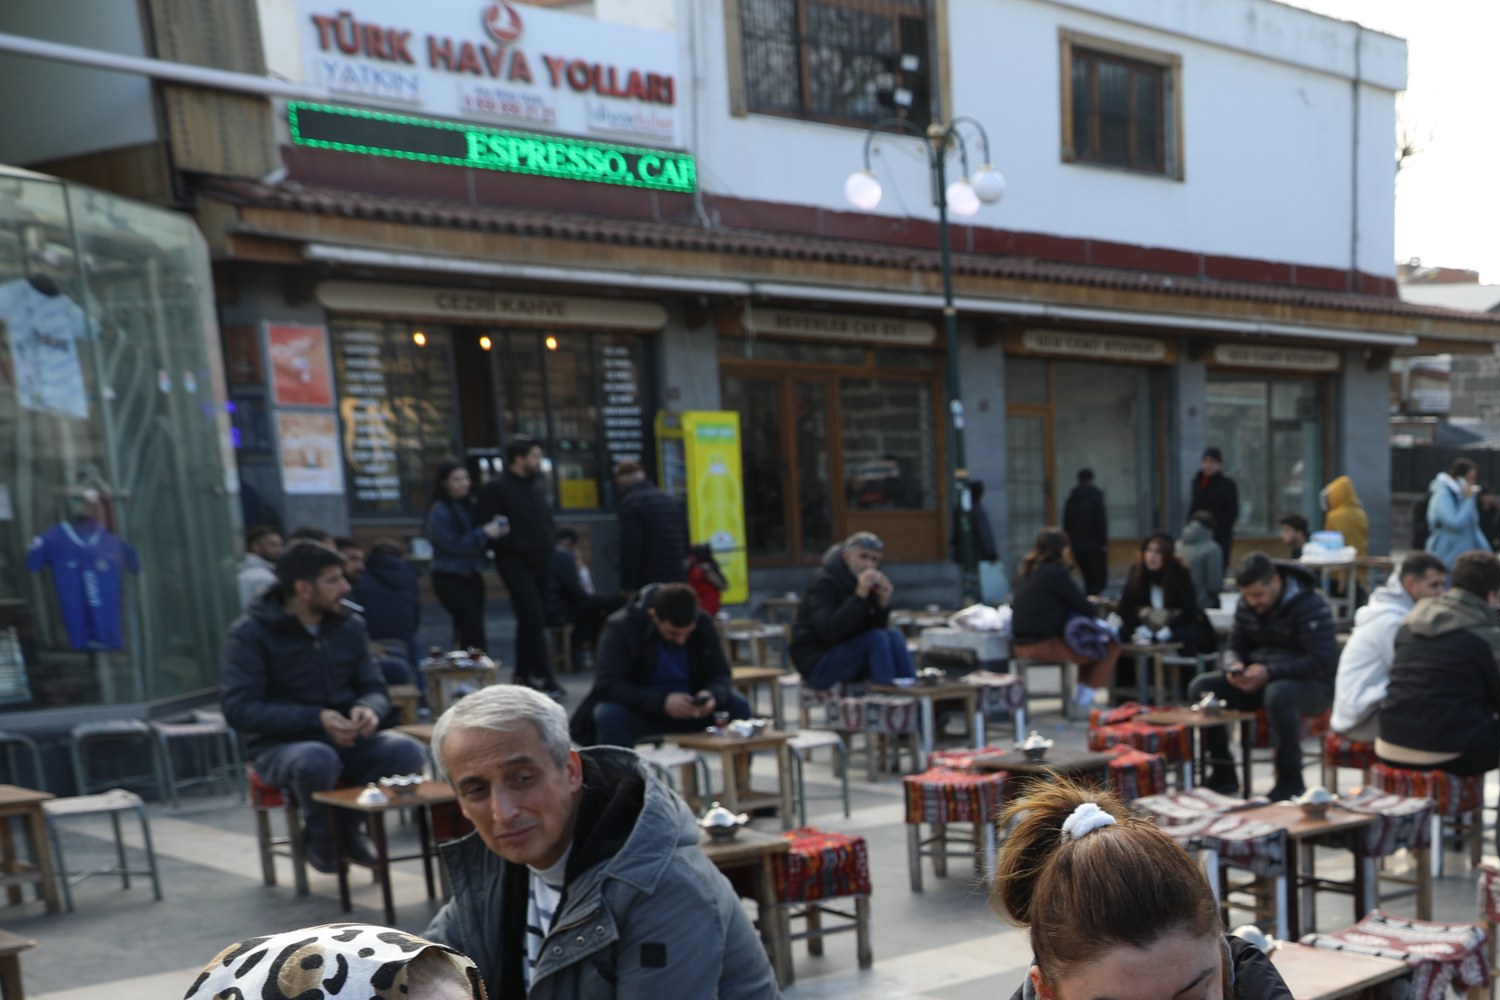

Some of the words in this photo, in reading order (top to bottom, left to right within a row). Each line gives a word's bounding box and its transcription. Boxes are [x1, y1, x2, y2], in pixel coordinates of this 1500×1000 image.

[311, 10, 416, 66] TÜRK
[426, 34, 533, 84] HAVA
[541, 52, 677, 106] YOLLARI
